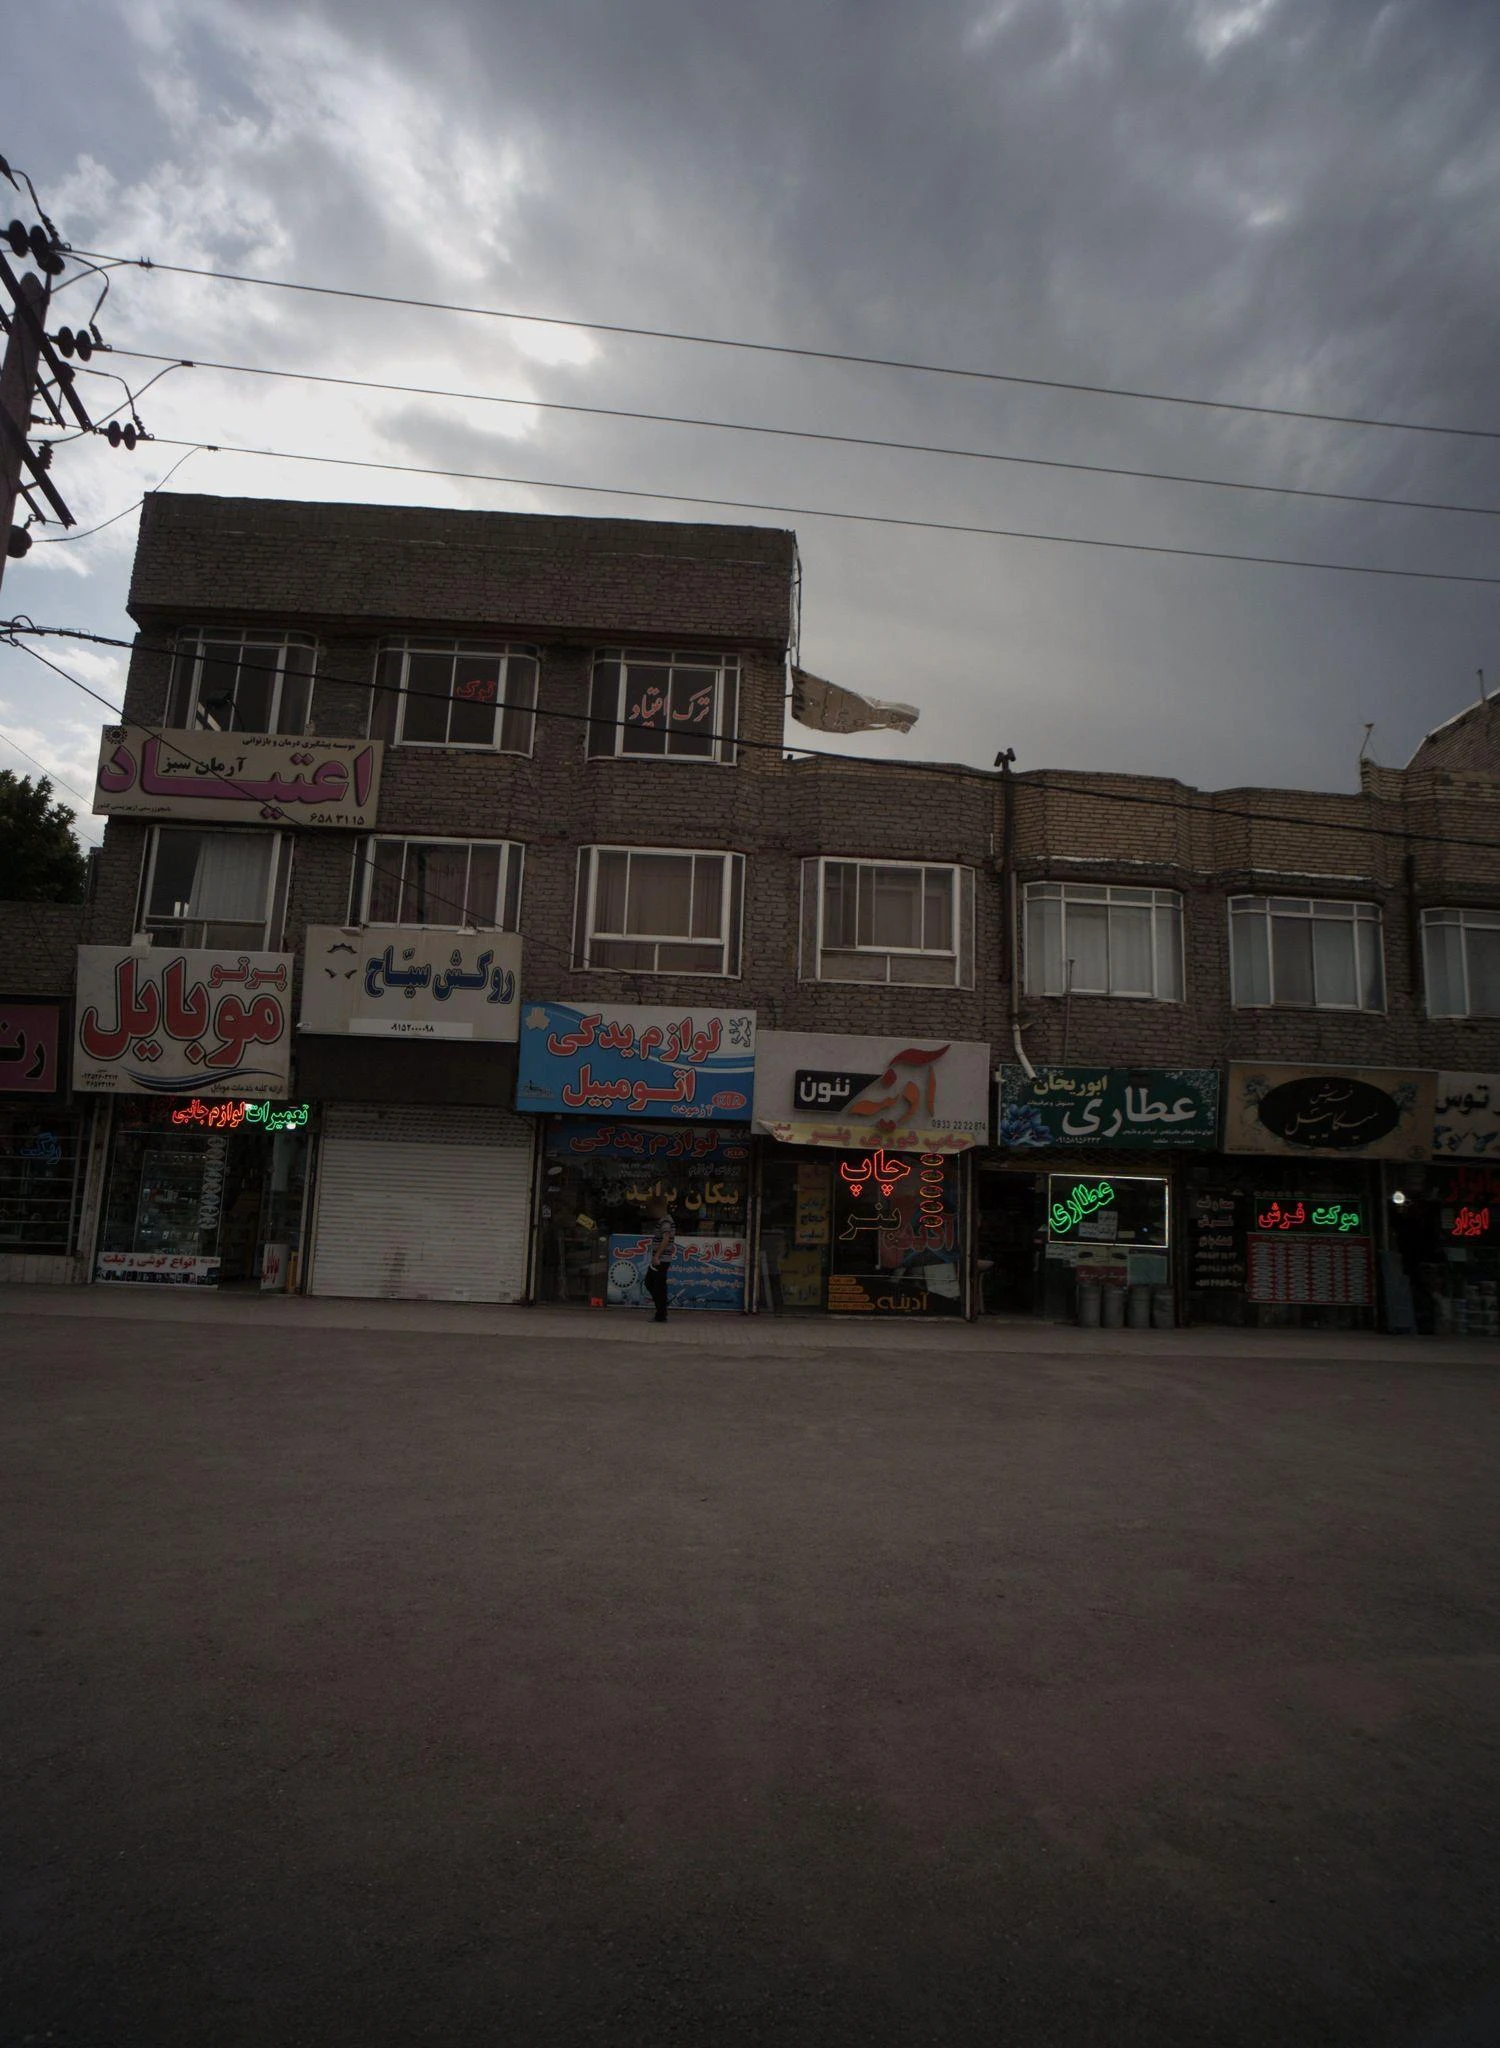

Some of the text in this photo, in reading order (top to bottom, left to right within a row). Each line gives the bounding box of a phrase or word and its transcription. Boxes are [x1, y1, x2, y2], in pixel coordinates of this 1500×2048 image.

[627, 685, 713, 728] ترک اعتیاد
[278, 738, 300, 747] درمان
[99, 735, 374, 820] اعتیاد
[161, 757, 247, 779] آرمان سبز
[208, 956, 287, 992] پرتو
[433, 948, 516, 1004] روکش
[80, 956, 285, 1068] موبایل
[547, 1013, 723, 1062] لوازم یدکی
[562, 1064, 696, 1111] اتومبیل
[799, 1075, 851, 1104] نئون
[848, 1044, 951, 1132] آدینه
[1033, 1074, 1108, 1097] ابوریحان
[1434, 1085, 1490, 1115] توس
[172, 1099, 209, 1126] جانبی
[209, 1101, 246, 1128] لوازم
[246, 1101, 310, 1131] تعمیرات
[1062, 1086, 1198, 1138] عطاری
[570, 1127, 719, 1158] لوازم یدکی
[840, 1148, 911, 1198] چاپ
[684, 1182, 740, 1214] پیکان
[1050, 1182, 1115, 1234] عطاری
[839, 1202, 902, 1241] بنر
[1258, 1201, 1305, 1229] فرش
[1312, 1204, 1360, 1232] موکت
[102, 1255, 127, 1265] تبلت
[136, 1255, 167, 1268] گوشی
[170, 1257, 197, 1270] انواع
[684, 1241, 742, 1263] لوازم
[876, 1290, 930, 1312] آدینه
